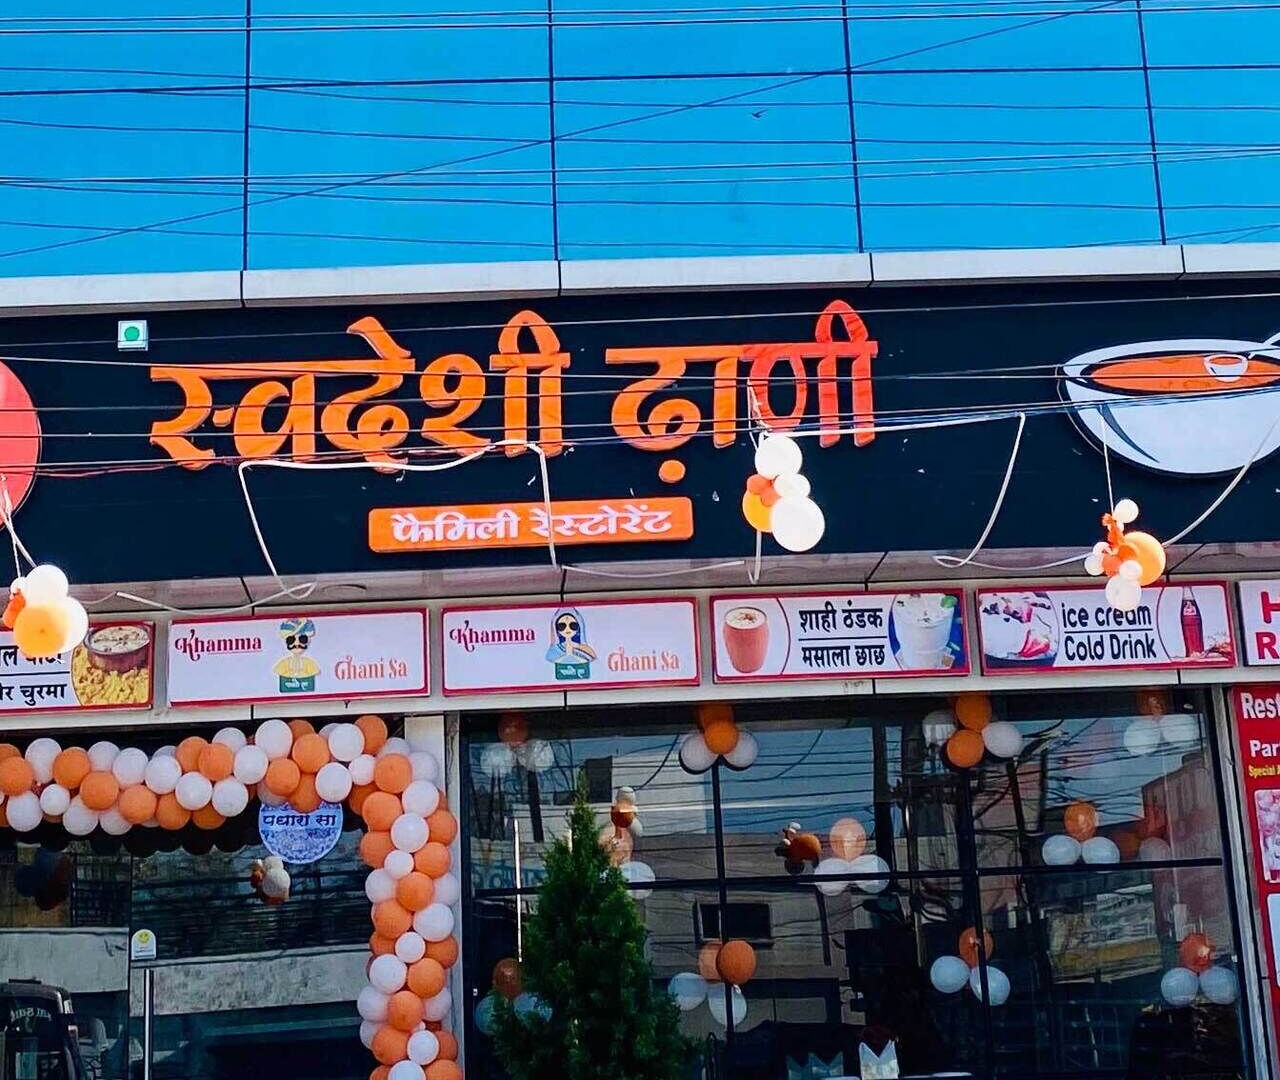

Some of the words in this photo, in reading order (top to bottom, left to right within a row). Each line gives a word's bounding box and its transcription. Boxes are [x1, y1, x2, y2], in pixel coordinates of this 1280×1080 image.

[150, 309, 571, 472] स्वदेशी
[606, 299, 879, 483] ढाणी
[390, 510, 520, 544] फैमिली
[528, 504, 673, 538] रेस्टोरेंट
[799, 601, 837, 633] शाही
[841, 600, 883, 628] ठंडक
[1061, 602, 1089, 628] ice
[1094, 605, 1152, 626] cream
[175, 628, 263, 660] Khamma
[446, 621, 536, 646] Khamma
[1064, 634, 1105, 661] Cold
[1109, 632, 1157, 660] Drink
[335, 655, 385, 681] Ghani
[388, 658, 408, 679] Sa
[607, 644, 657, 672] Ghani
[660, 650, 680, 671] Sa
[801, 646, 851, 668] मसाला
[854, 645, 885, 666] छाछ
[19, 684, 67, 706] चुरमा
[1248, 765, 1275, 778] Special
